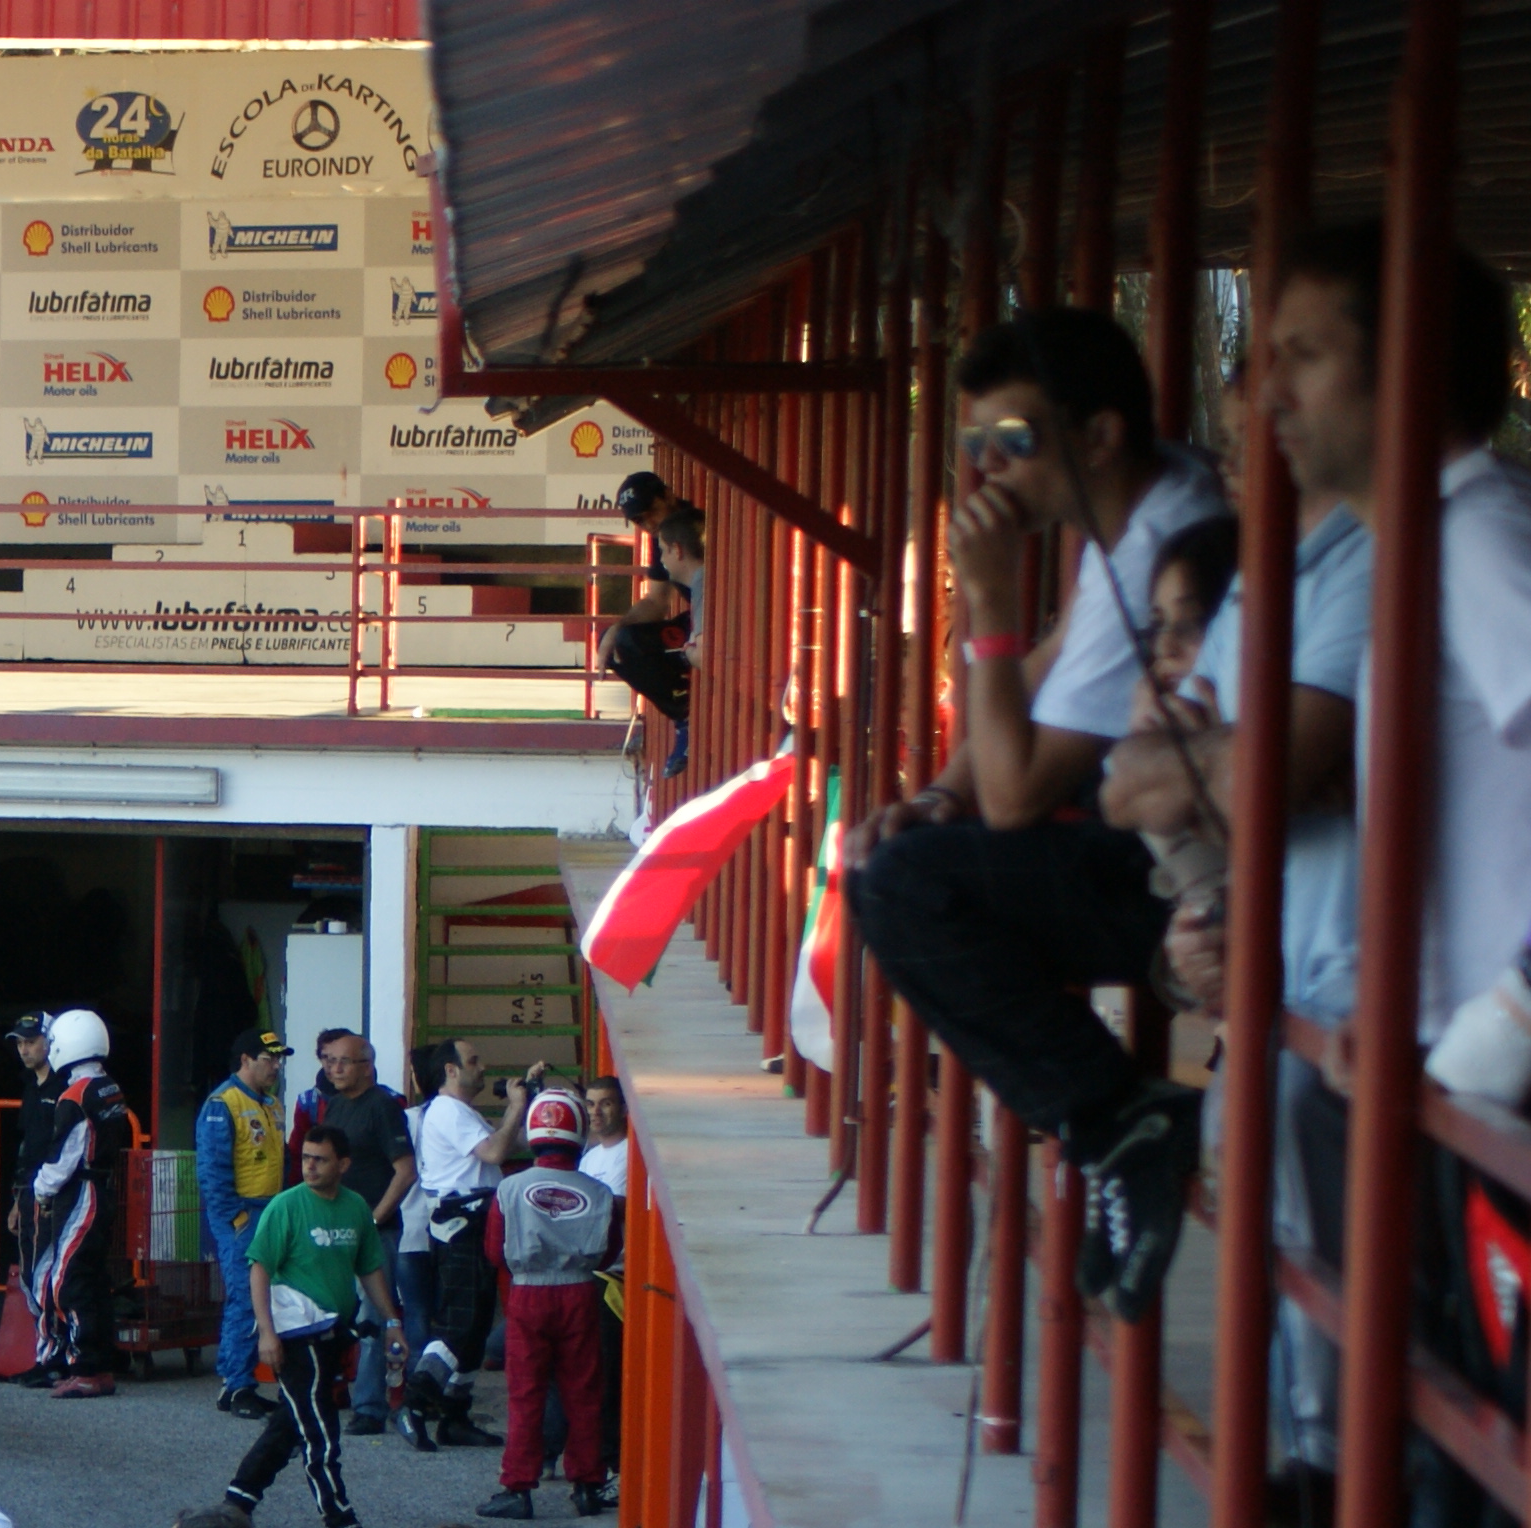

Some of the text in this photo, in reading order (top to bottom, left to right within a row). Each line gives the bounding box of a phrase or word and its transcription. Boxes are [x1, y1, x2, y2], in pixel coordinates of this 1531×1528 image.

[90, 96, 150, 139] 24
[211, 73, 419, 180] ESCOLA DE KARTING
[86, 144, 165, 160] da Batalha
[8, 156, 16, 164] of
[18, 156, 47, 164] Dreams
[263, 156, 373, 178] EUROINDY
[61, 225, 134, 237] Distribuidor
[234, 229, 334, 245] MICHELIN
[61, 242, 158, 254] Shell Lubricants
[242, 291, 316, 303] Distribuidor
[242, 308, 341, 320] Shell Lubricants
[44, 362, 128, 382] HELIX
[44, 386, 97, 397] Motor oils
[50, 437, 148, 452] MICHELIN
[225, 429, 311, 449] HELIX
[611, 444, 642, 456] Shell
[225, 453, 280, 464] Motor oils
[58, 496, 131, 507] Distribuidor
[58, 514, 155, 526] Shell Lubricants
[406, 521, 461, 533] Motor oils
[238, 530, 247, 547] 1
[66, 577, 75, 593] 4
[418, 596, 427, 614] 5
[506, 624, 516, 642] 7
[95, 635, 351, 650] ESPECIALISTAS EM PNEUS E LUBRIFICANTE
